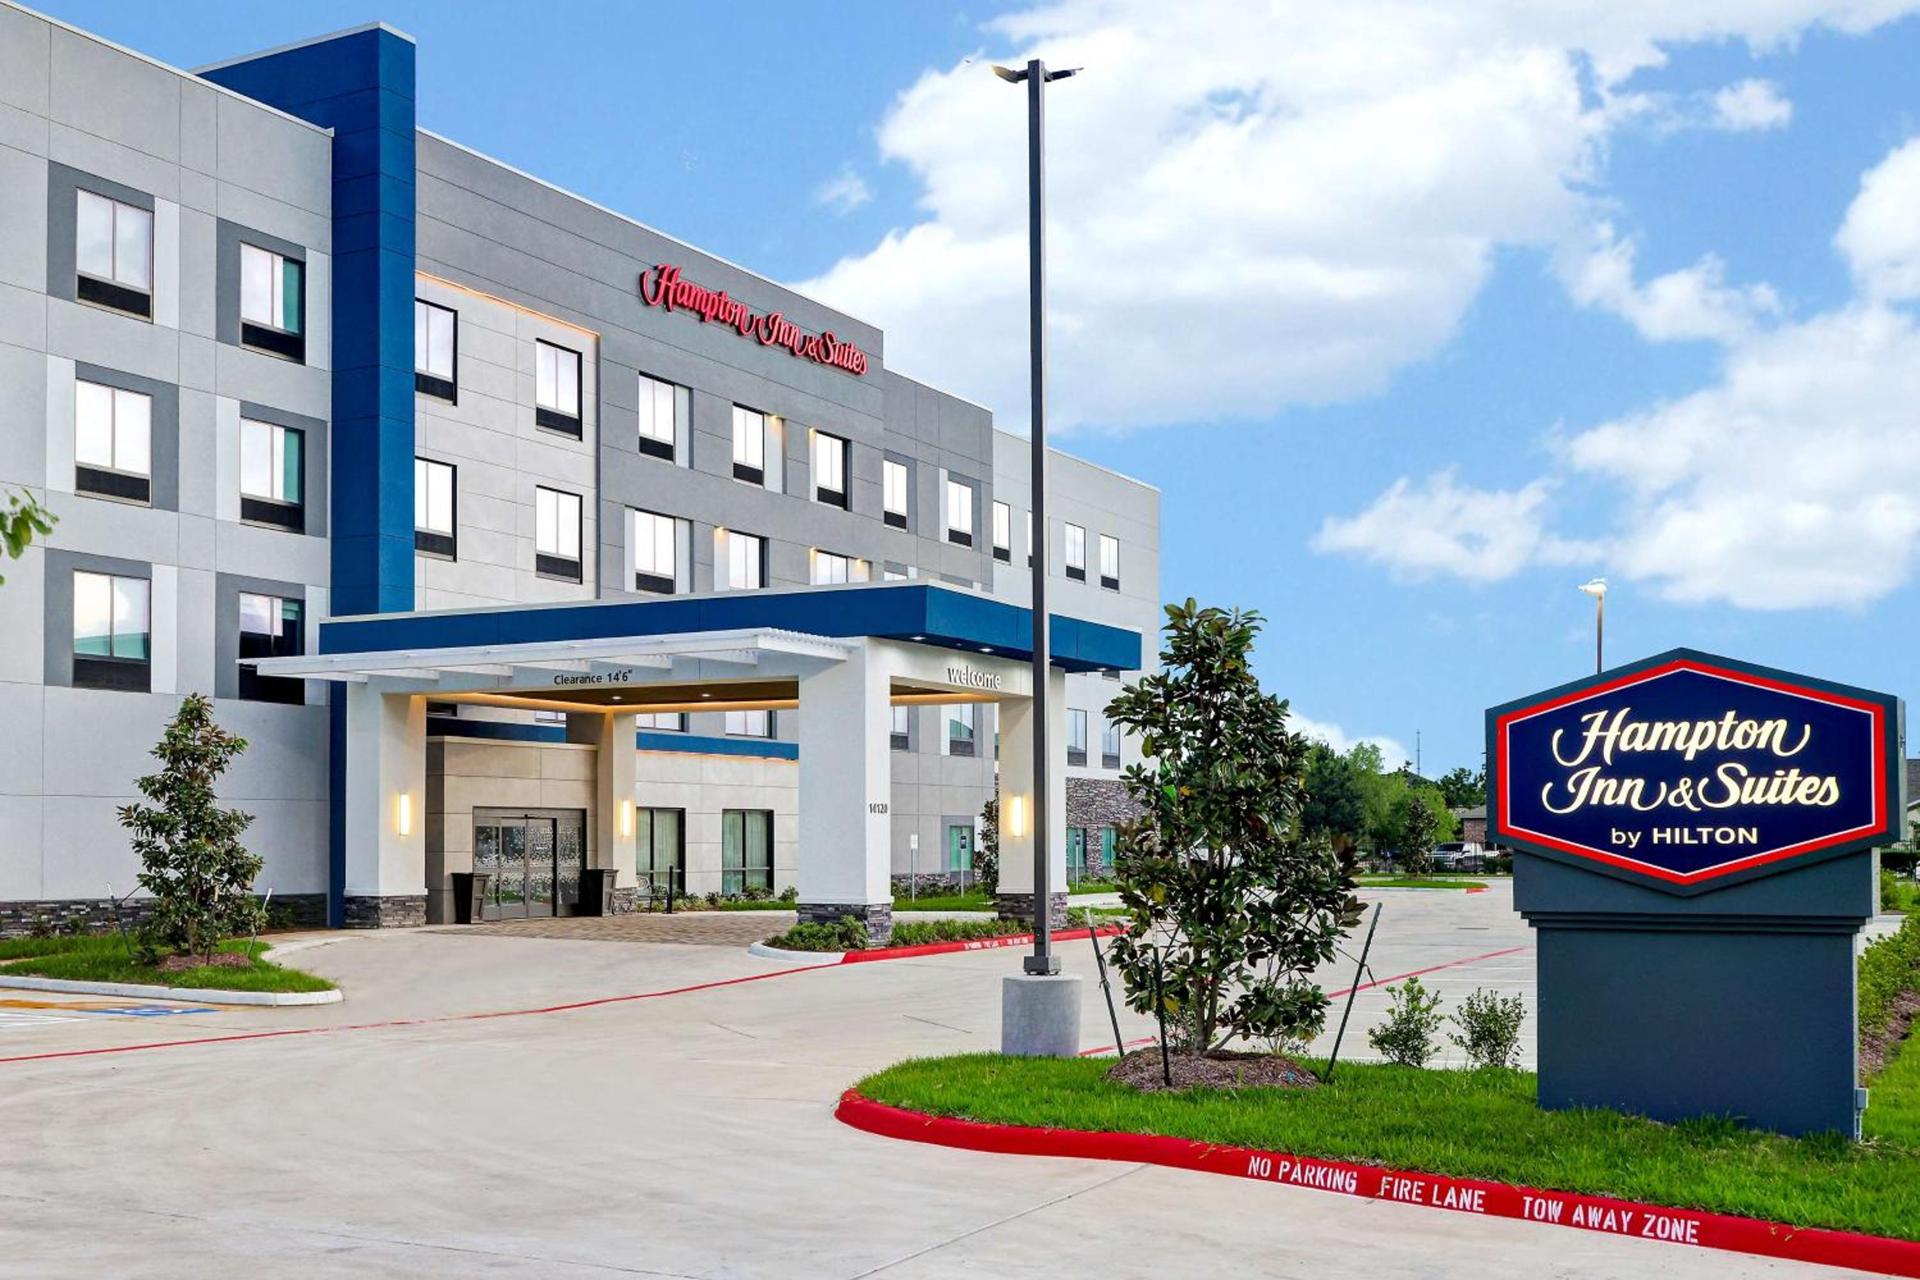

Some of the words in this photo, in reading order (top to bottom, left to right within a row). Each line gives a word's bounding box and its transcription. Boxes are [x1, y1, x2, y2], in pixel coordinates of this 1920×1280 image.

[640, 264, 756, 336] Hampton
[756, 312, 808, 356] Inn
[807, 336, 821, 362] &
[819, 331, 868, 374] Suites
[554, 674, 602, 685] Clearance
[947, 665, 1001, 690] welcome
[1551, 707, 1811, 766] Hampton
[1542, 765, 1669, 814] Inn
[1667, 778, 1701, 812] &
[1697, 763, 1840, 809] Suites
[1611, 827, 1642, 848] by
[1652, 827, 1758, 845] HILTON
[1247, 1156, 1271, 1177] NO
[1278, 1160, 1358, 1194] PARKING
[1380, 1175, 1425, 1202] FIRE
[1432, 1184, 1486, 1212] LANE
[1523, 1196, 1563, 1223] TOW
[1572, 1204, 1633, 1233] AWAY
[1642, 1214, 1701, 1244] ZONE
